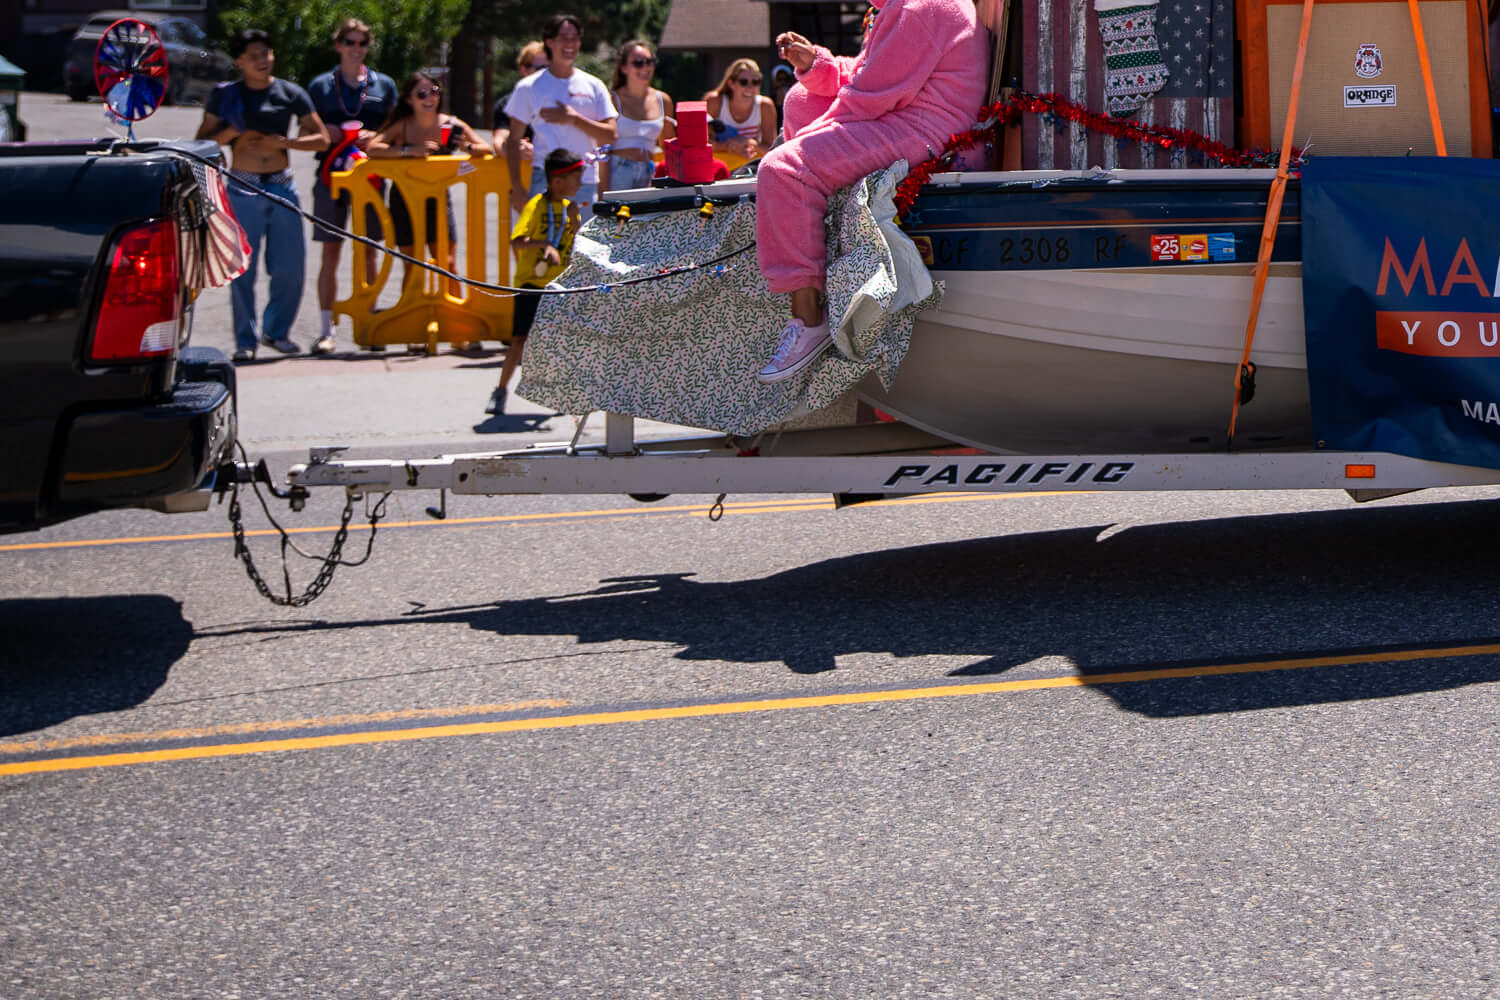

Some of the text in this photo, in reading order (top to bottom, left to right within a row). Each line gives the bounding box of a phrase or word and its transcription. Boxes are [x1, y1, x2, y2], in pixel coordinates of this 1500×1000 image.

[1347, 89, 1393, 103] ORANGE
[938, 234, 1129, 264] CF 2308 RF
[1160, 239, 1179, 255] 25
[882, 461, 1137, 487] PACIFIC
